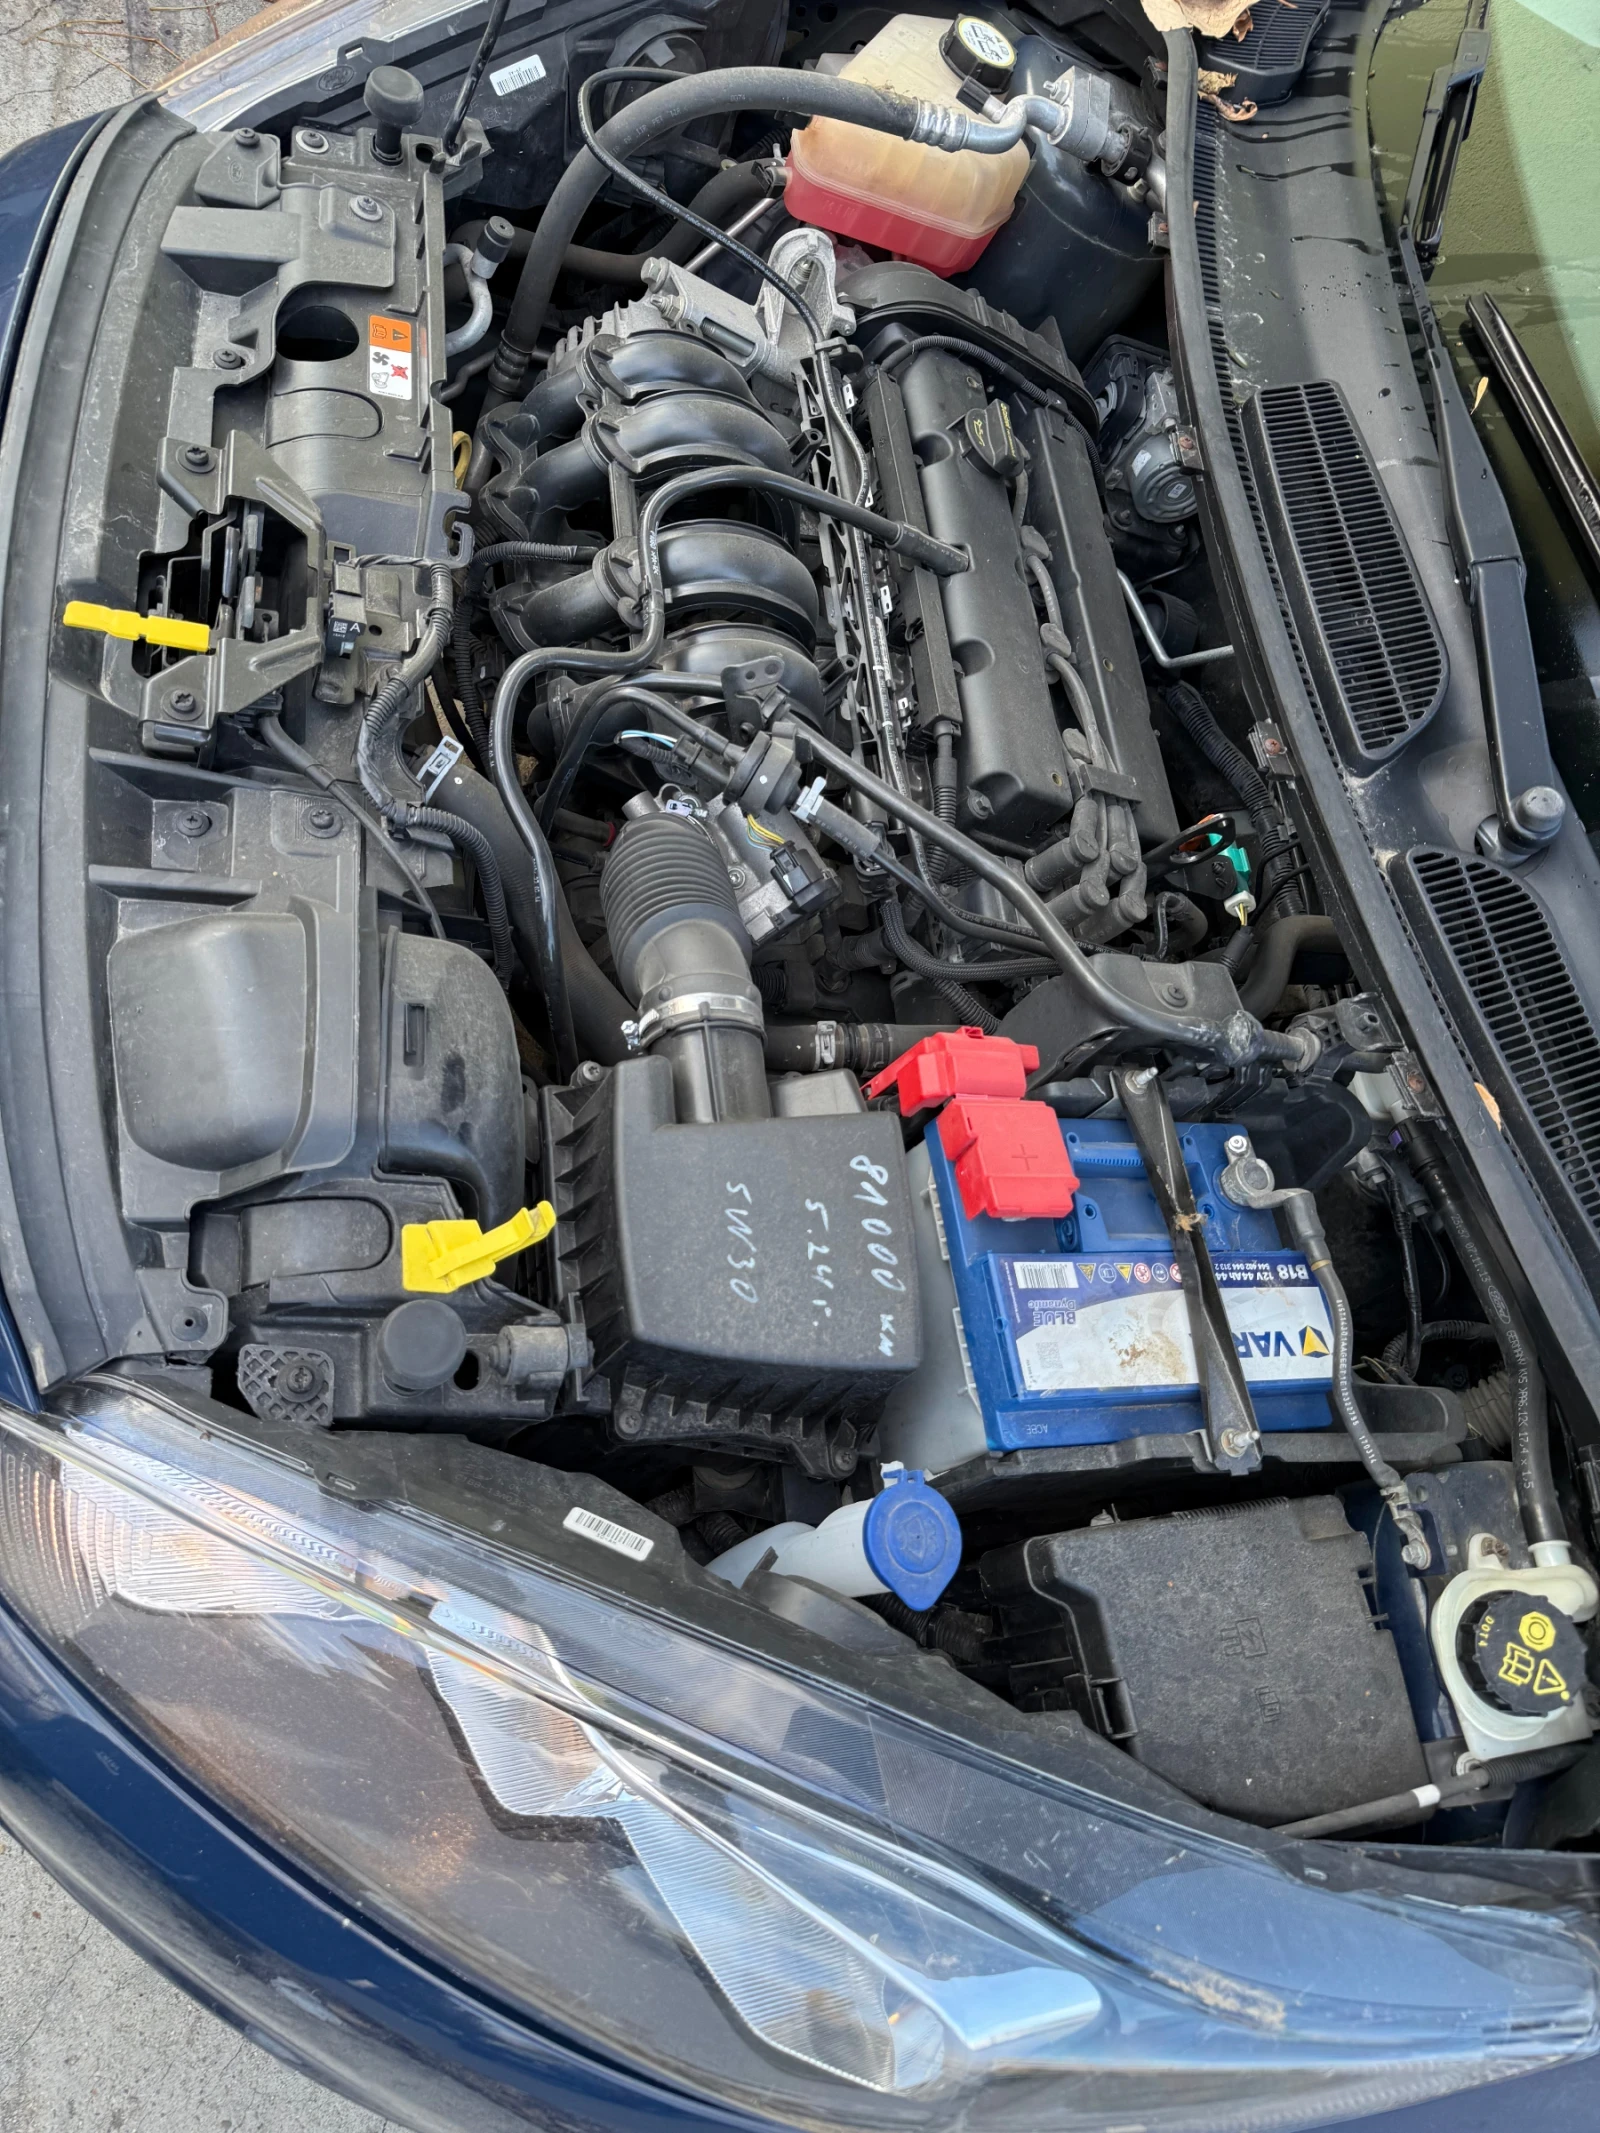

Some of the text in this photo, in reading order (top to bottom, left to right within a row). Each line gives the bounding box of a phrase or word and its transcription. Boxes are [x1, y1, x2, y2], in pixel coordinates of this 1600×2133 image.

[350, 622, 361, 633] A
[725, 1181, 759, 1304] 5W30
[1465, 1242, 1491, 1283] 07.11.13
[1215, 1264, 1310, 1281] B18 12V 44Ah 44
[1027, 1297, 1077, 1311] Dynamic
[1032, 1310, 1077, 1327] BLUE
[1188, 1331, 1297, 1358] VAR
